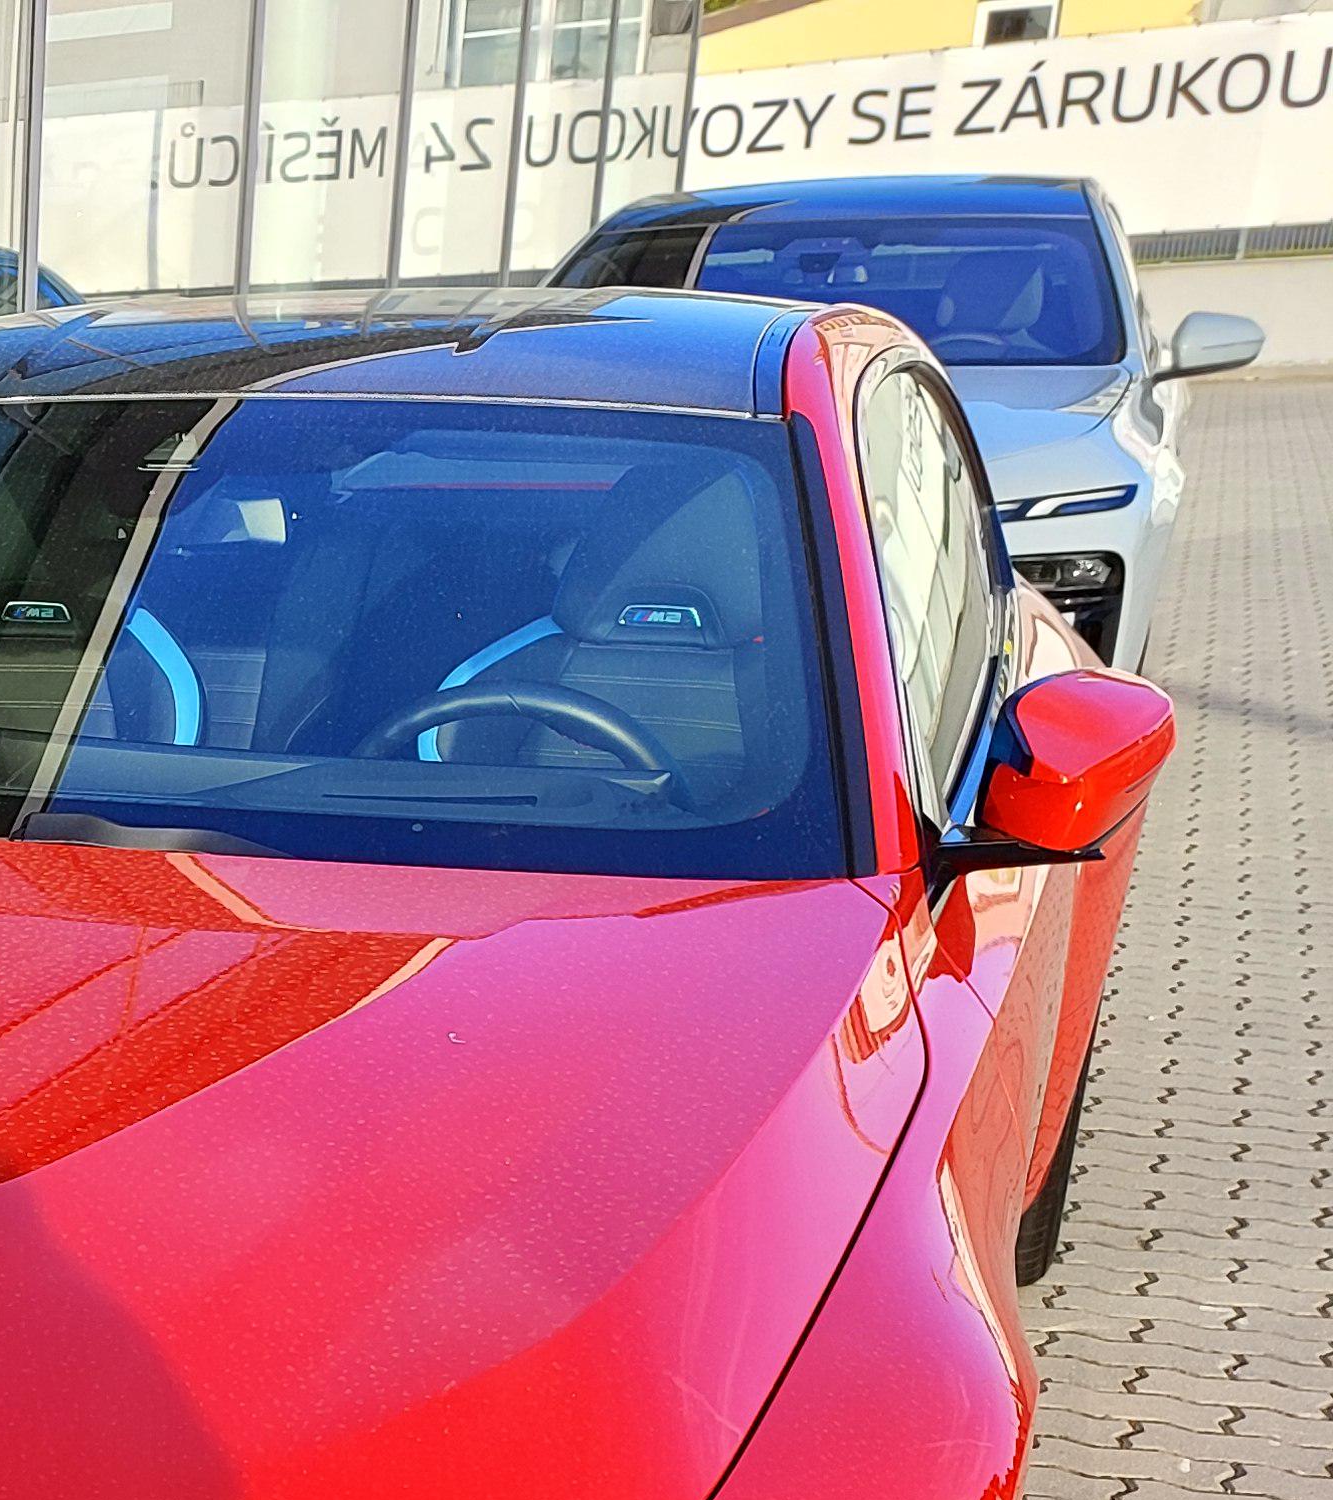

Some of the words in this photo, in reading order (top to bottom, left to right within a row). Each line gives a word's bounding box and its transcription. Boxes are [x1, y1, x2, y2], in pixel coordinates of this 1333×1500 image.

[685, 93, 836, 160] OZY
[848, 84, 936, 147] SE
[953, 46, 1333, 136] ZÁRUKOU
